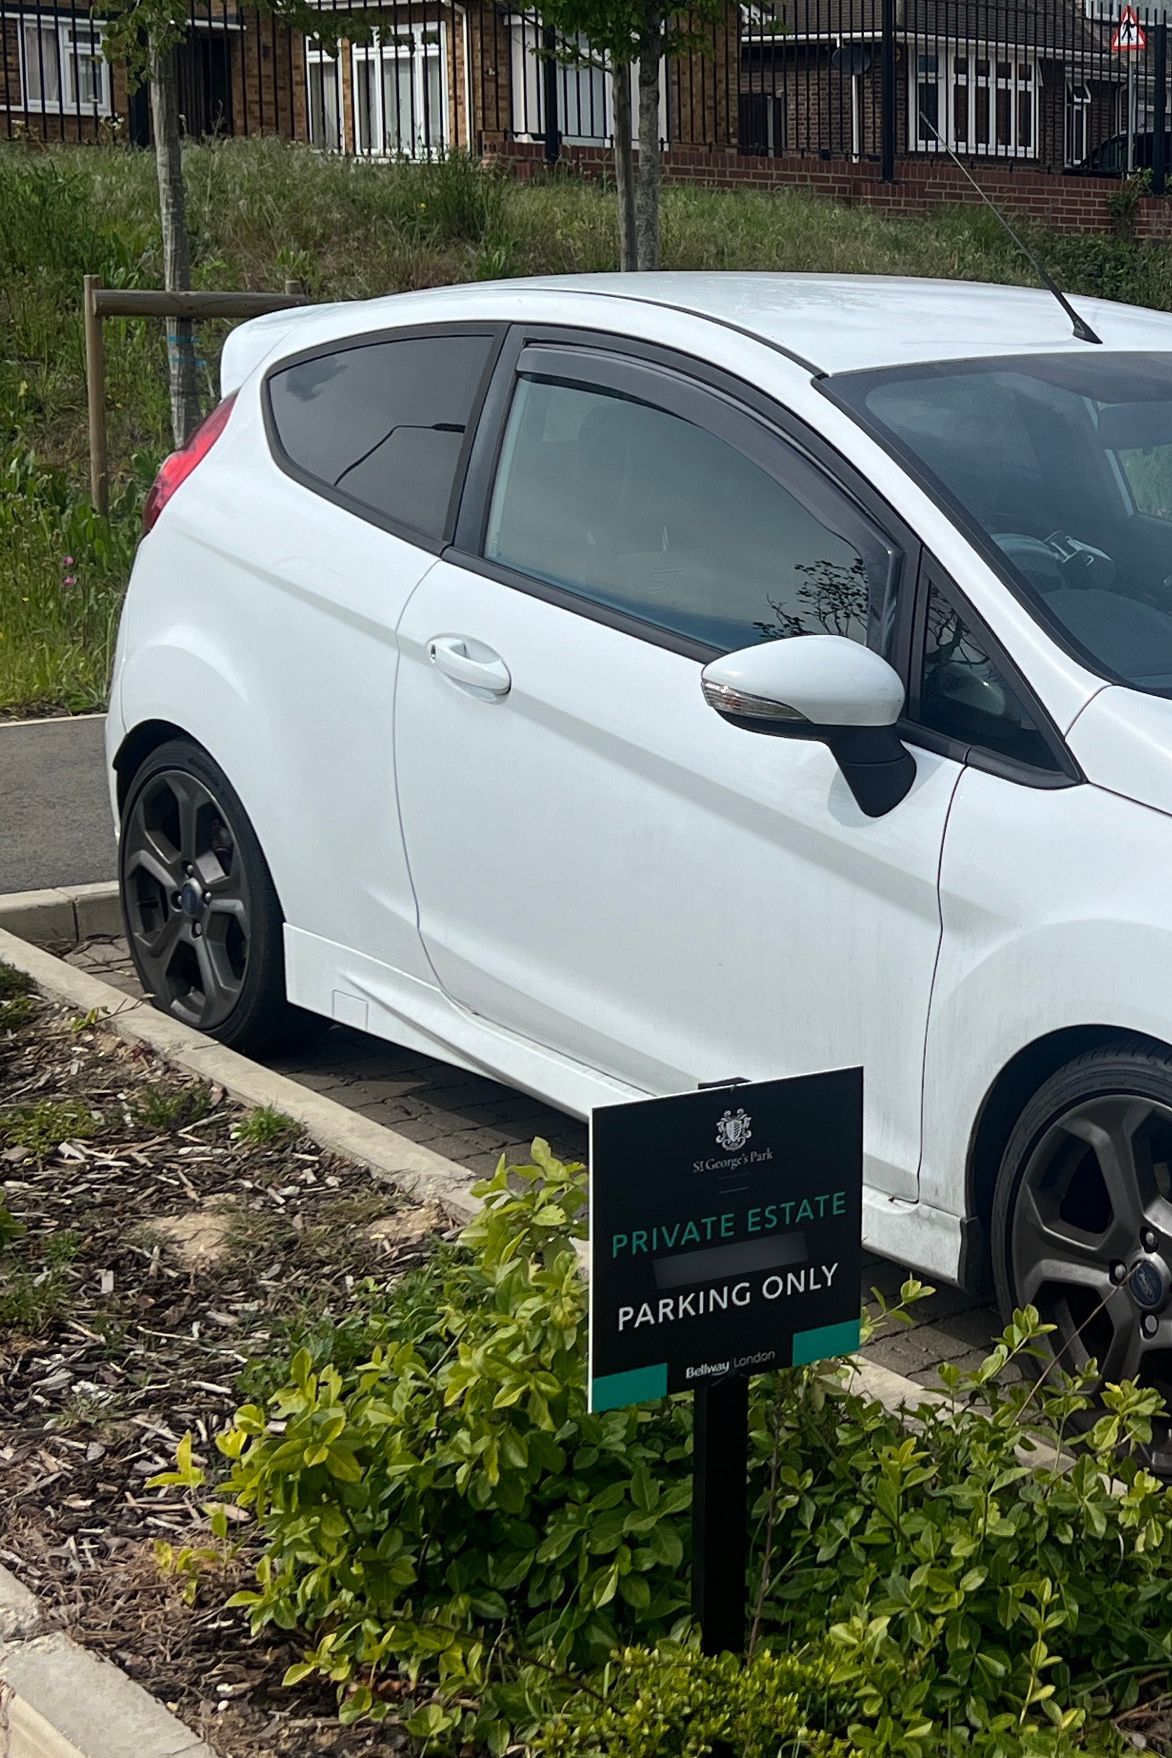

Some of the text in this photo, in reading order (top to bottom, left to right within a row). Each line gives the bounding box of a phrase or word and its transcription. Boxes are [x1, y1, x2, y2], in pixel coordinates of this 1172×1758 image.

[705, 1152, 749, 1170] George's
[750, 1147, 773, 1163] Park
[612, 1191, 847, 1259] PRIVATE ESTATE
[617, 1262, 839, 1332] PARKING ONLY
[686, 1350, 776, 1379] Bellway London
